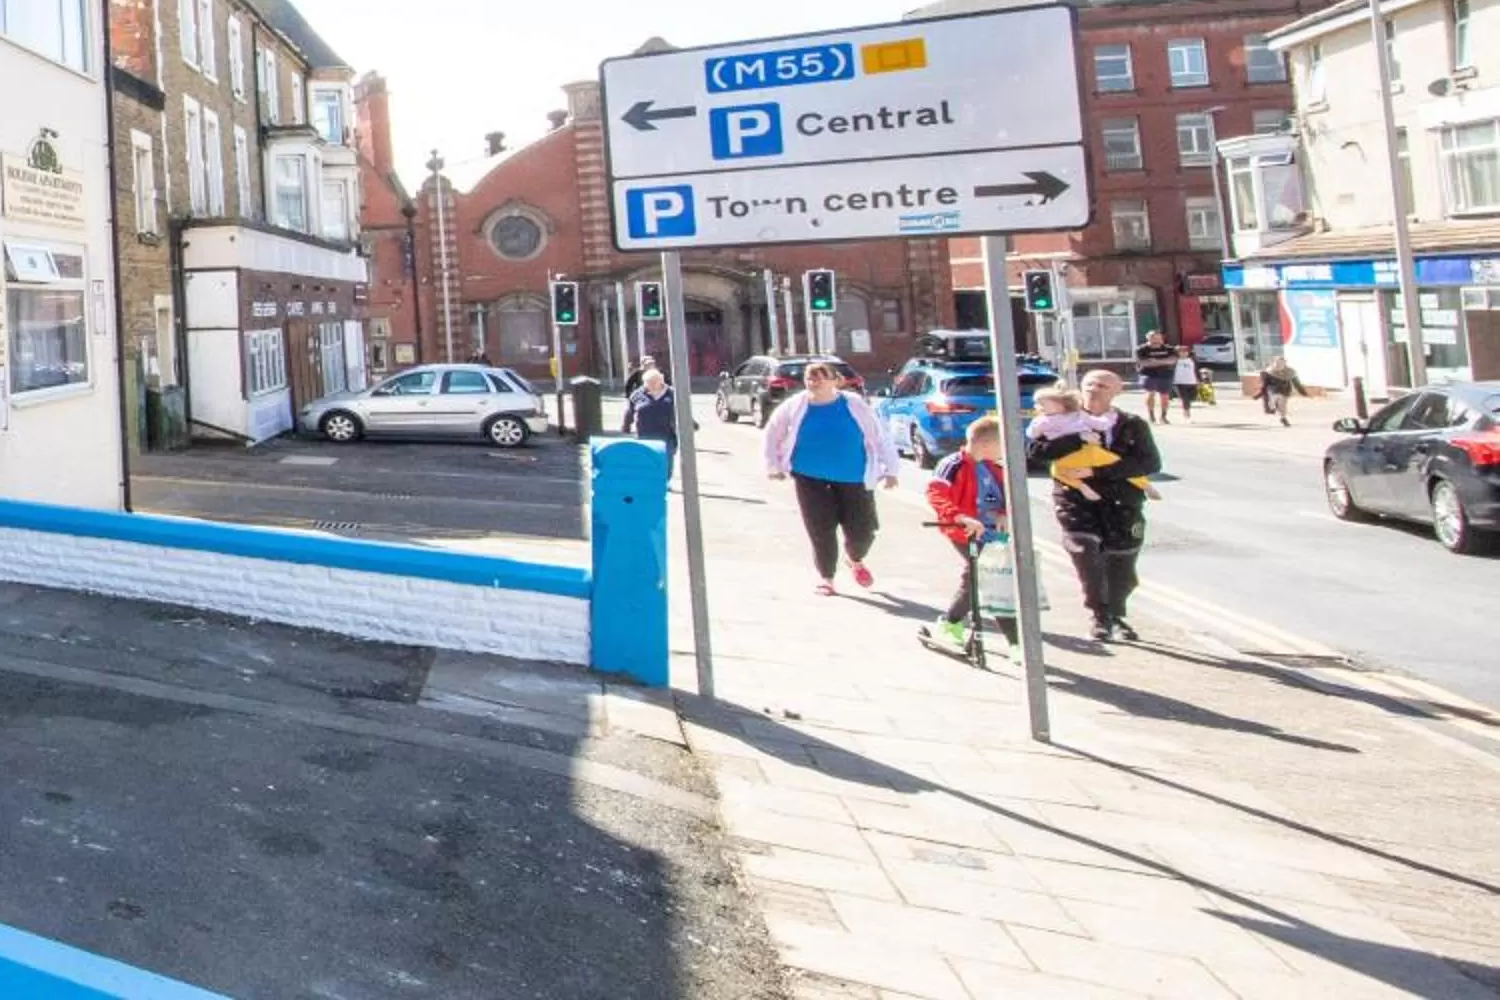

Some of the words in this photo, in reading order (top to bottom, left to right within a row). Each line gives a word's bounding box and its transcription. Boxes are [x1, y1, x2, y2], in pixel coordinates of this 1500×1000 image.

[726, 110, 771, 154] P
[796, 101, 955, 137] Central
[642, 191, 683, 234] P
[707, 194, 807, 219] Ton
[824, 184, 958, 213] centre
